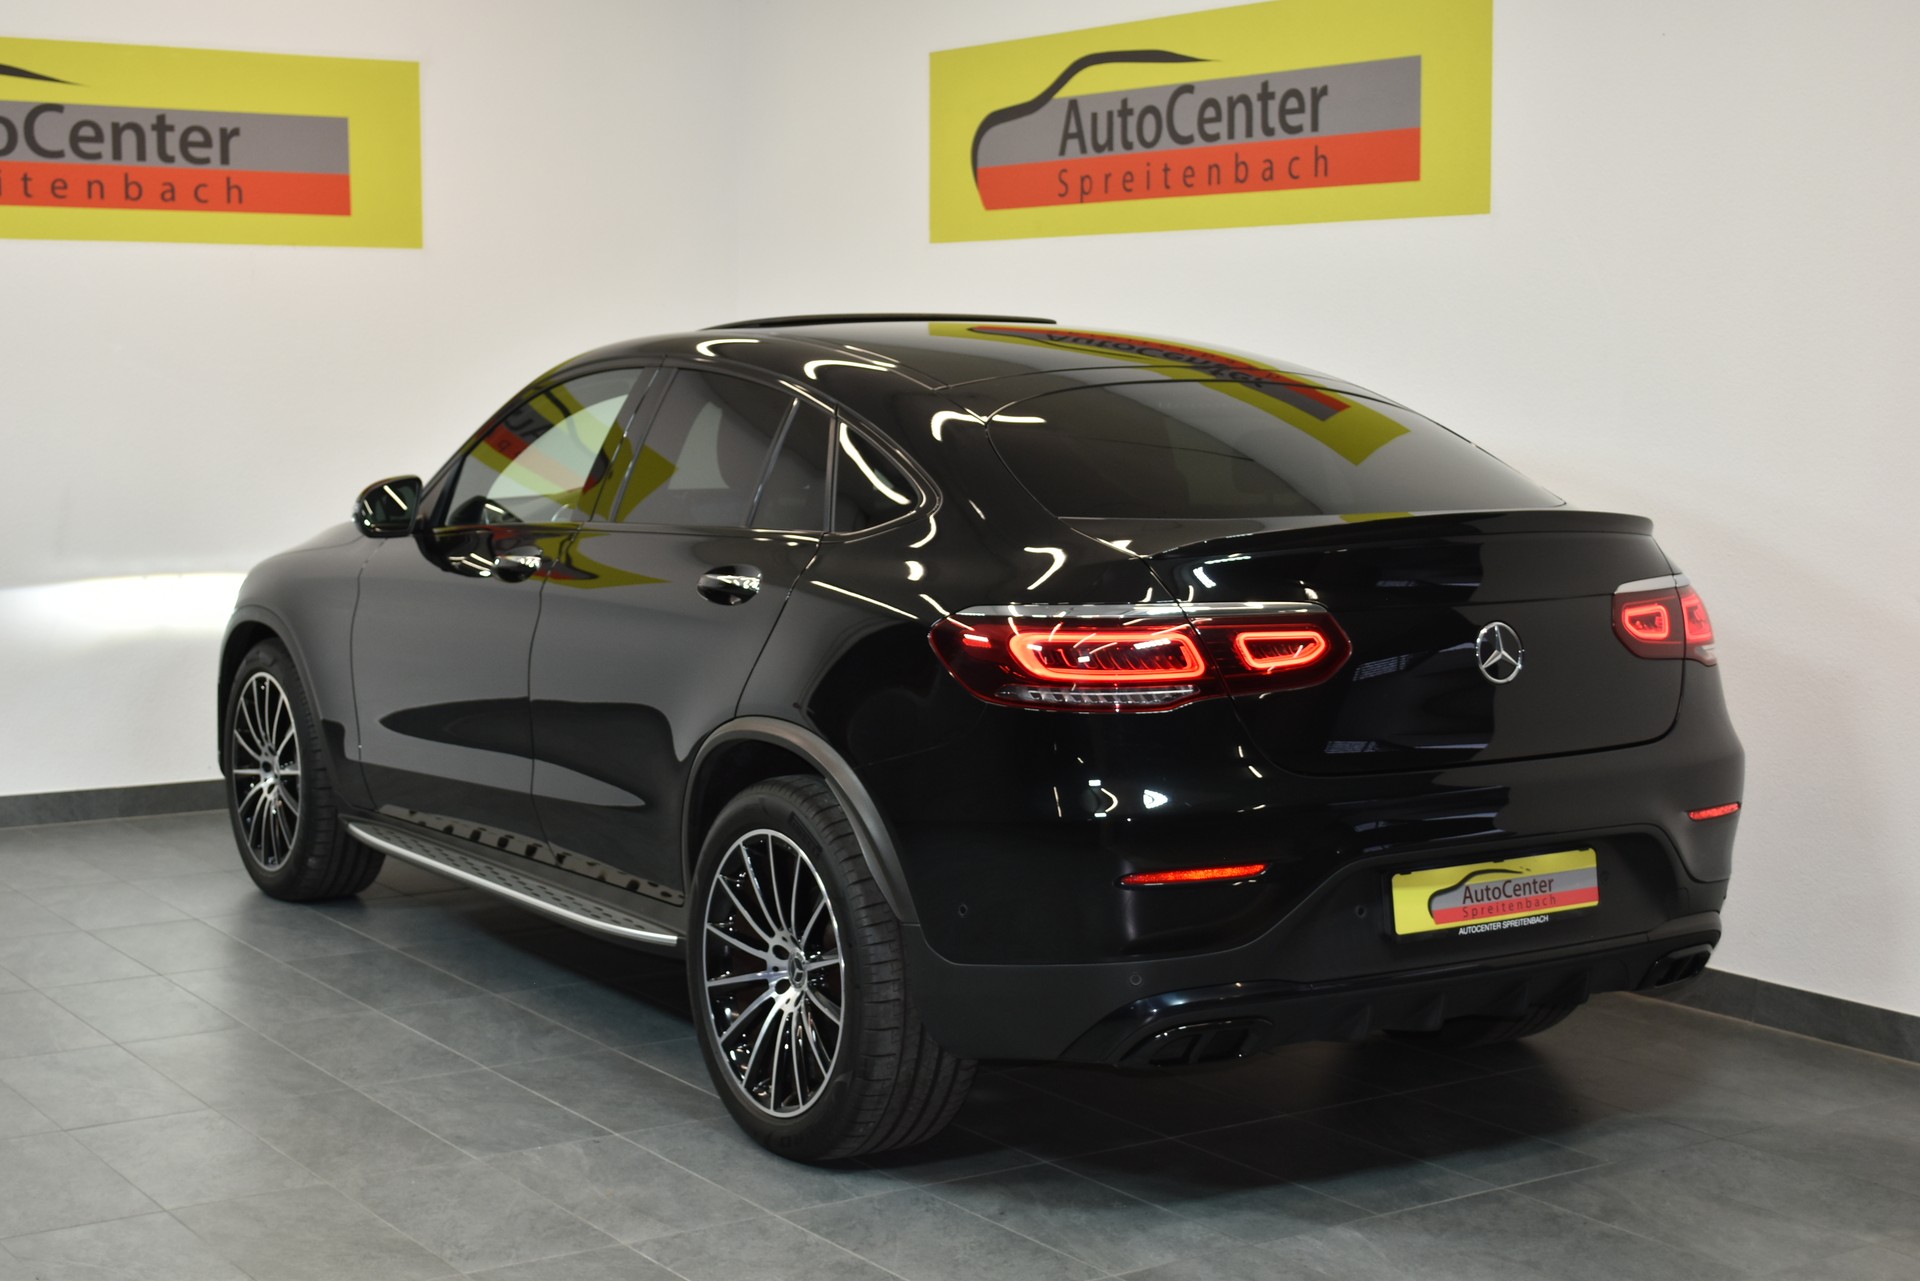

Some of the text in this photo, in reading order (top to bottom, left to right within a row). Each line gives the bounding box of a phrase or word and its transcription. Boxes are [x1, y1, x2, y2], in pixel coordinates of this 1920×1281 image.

[1059, 80, 1328, 156] AutoCenter
[1058, 145, 1328, 203] Spreitenbach
[1462, 878, 1554, 904] AutoCenter
[1463, 896, 1556, 918] Spreitenbach
[1458, 915, 1549, 936] AUTOCENTER SPREITENBACH
